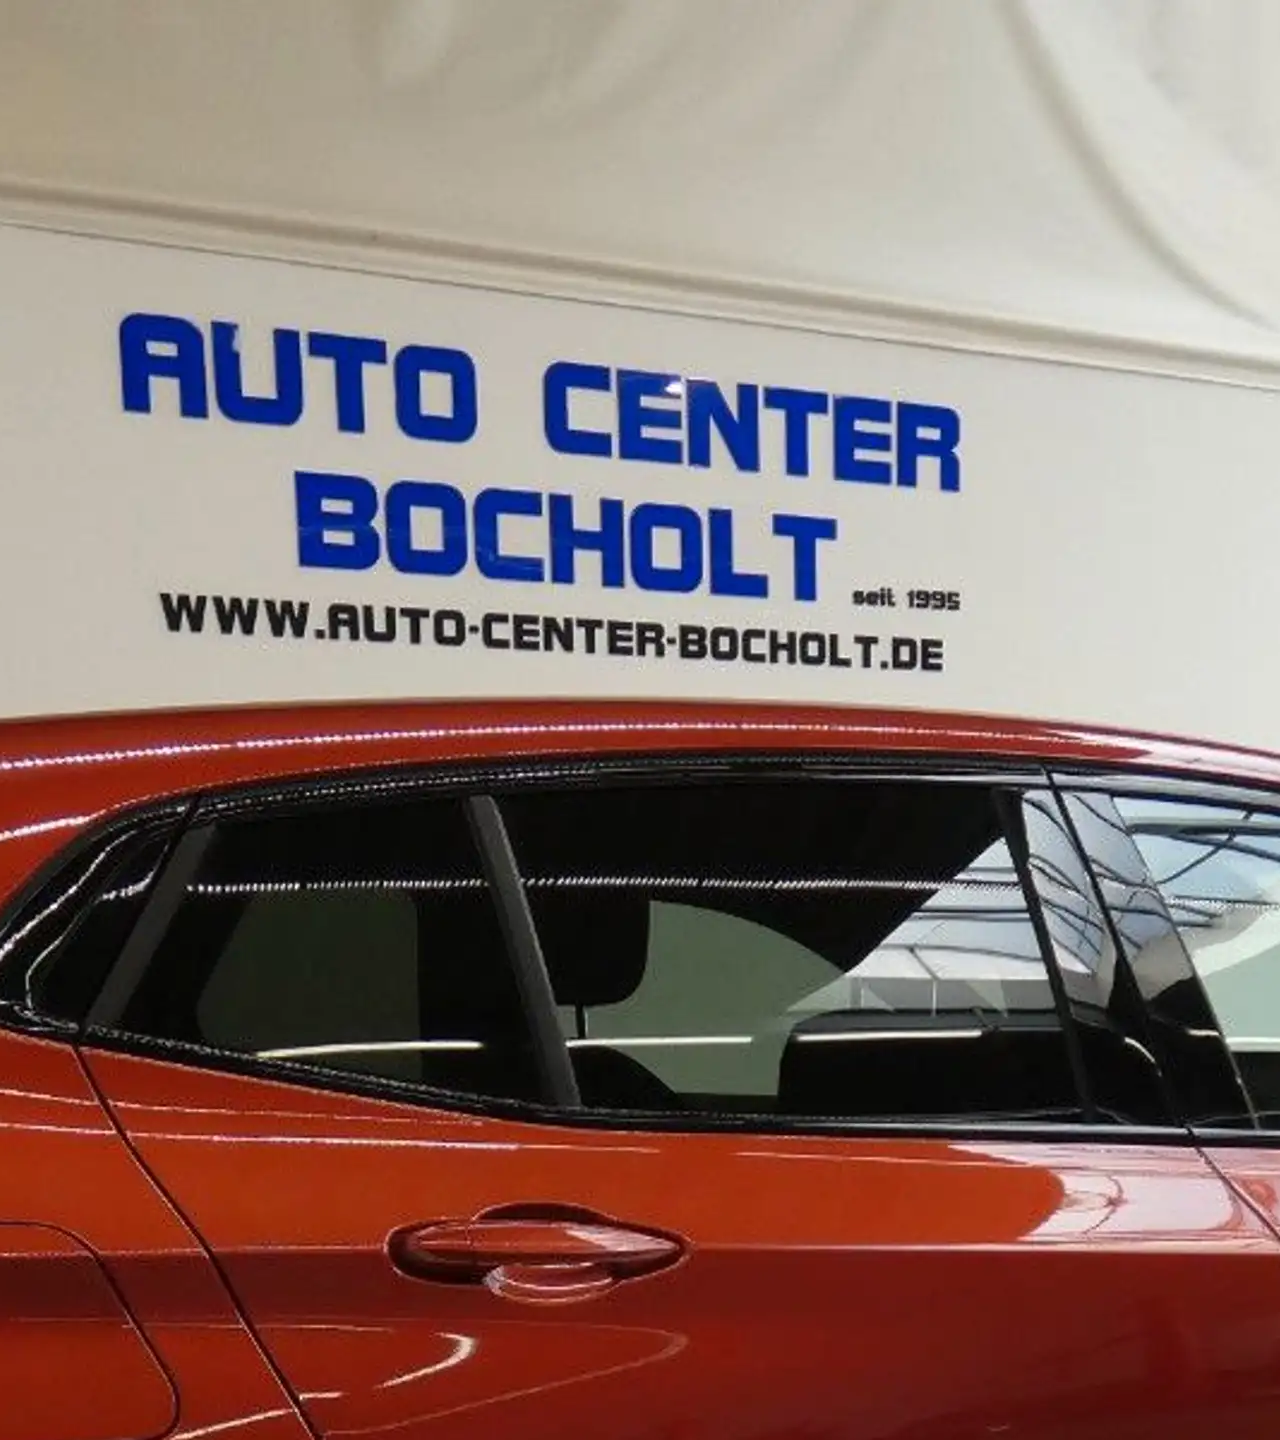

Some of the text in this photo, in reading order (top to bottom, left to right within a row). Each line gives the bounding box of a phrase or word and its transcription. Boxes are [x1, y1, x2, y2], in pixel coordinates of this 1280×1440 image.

[120, 313, 961, 493] AUTO CENTER
[294, 469, 837, 603] BOCHOLT
[159, 591, 944, 672] WWW.AUTO-CENTER-BOCHOLT.DE
[852, 587, 960, 611] seit 1995
